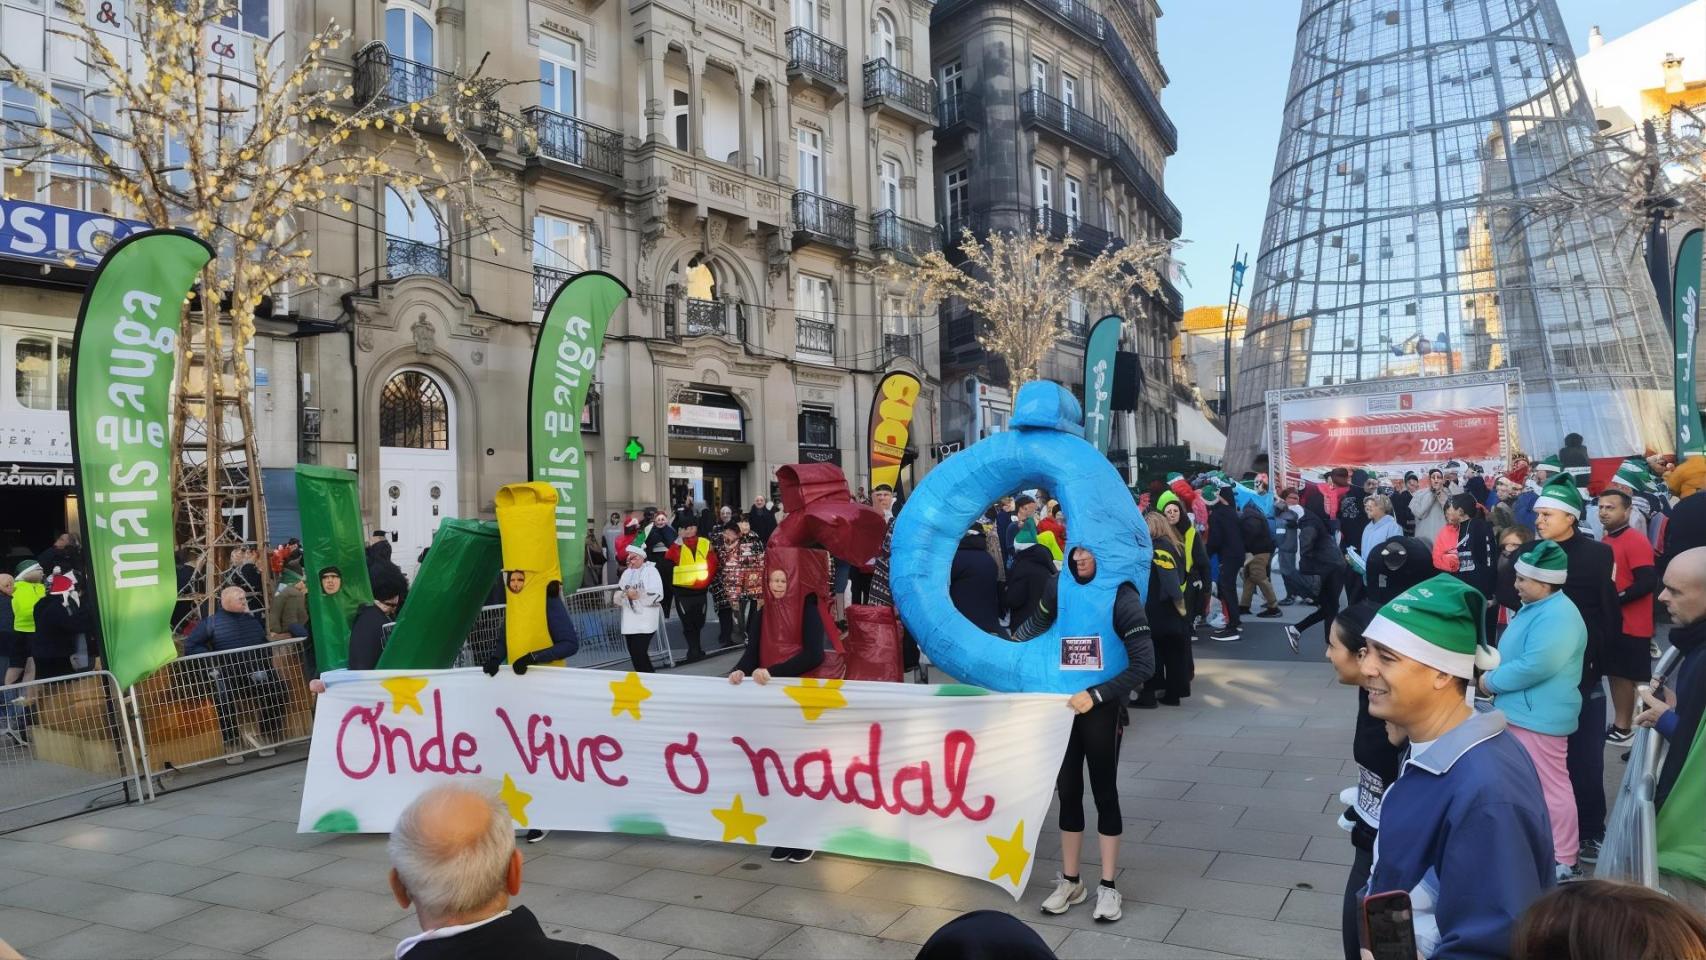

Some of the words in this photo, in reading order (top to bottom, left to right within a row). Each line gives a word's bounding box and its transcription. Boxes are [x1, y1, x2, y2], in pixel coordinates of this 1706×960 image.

[108, 290, 175, 413] auga
[95, 460, 159, 589] máis
[337, 689, 482, 780] Onde
[495, 706, 629, 787] Vive
[731, 722, 995, 822] nadal
